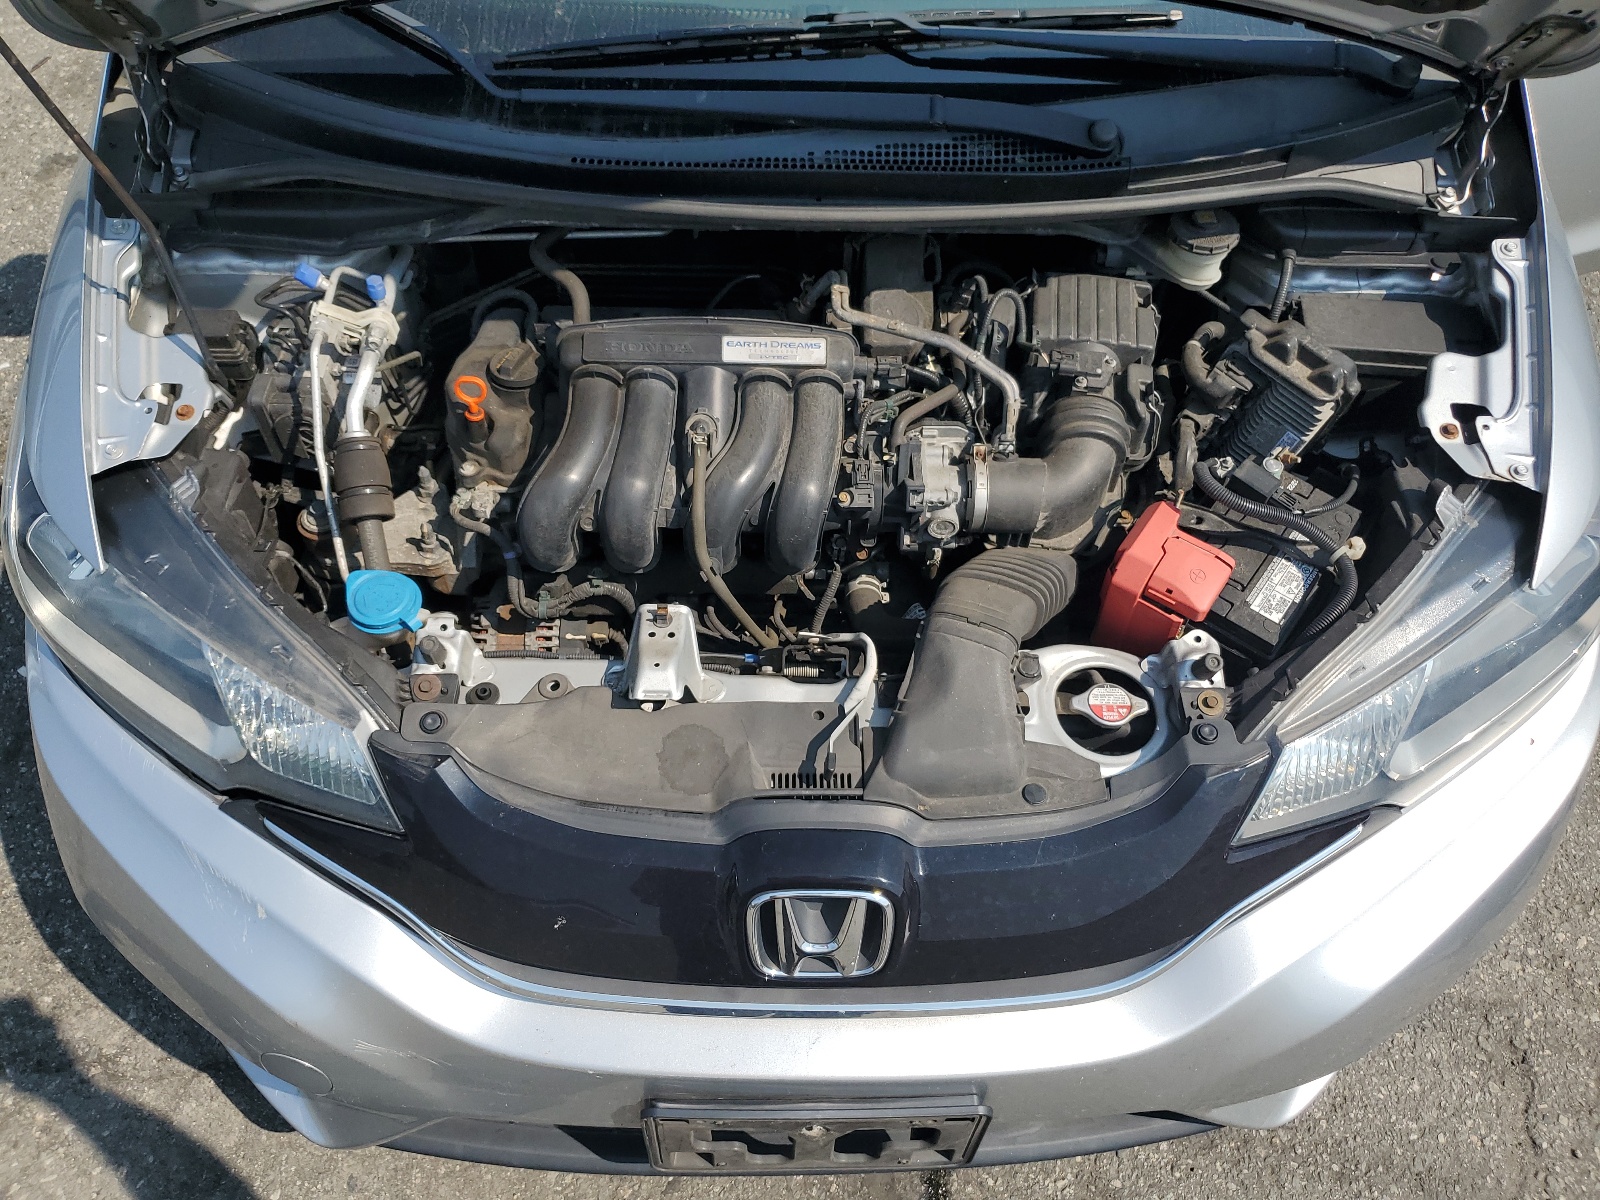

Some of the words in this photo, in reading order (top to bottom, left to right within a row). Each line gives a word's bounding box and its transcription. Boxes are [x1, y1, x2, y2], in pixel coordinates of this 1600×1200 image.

[605, 340, 695, 353] HONDA
[726, 340, 768, 348] EARTH
[770, 340, 821, 349] DREAMS
